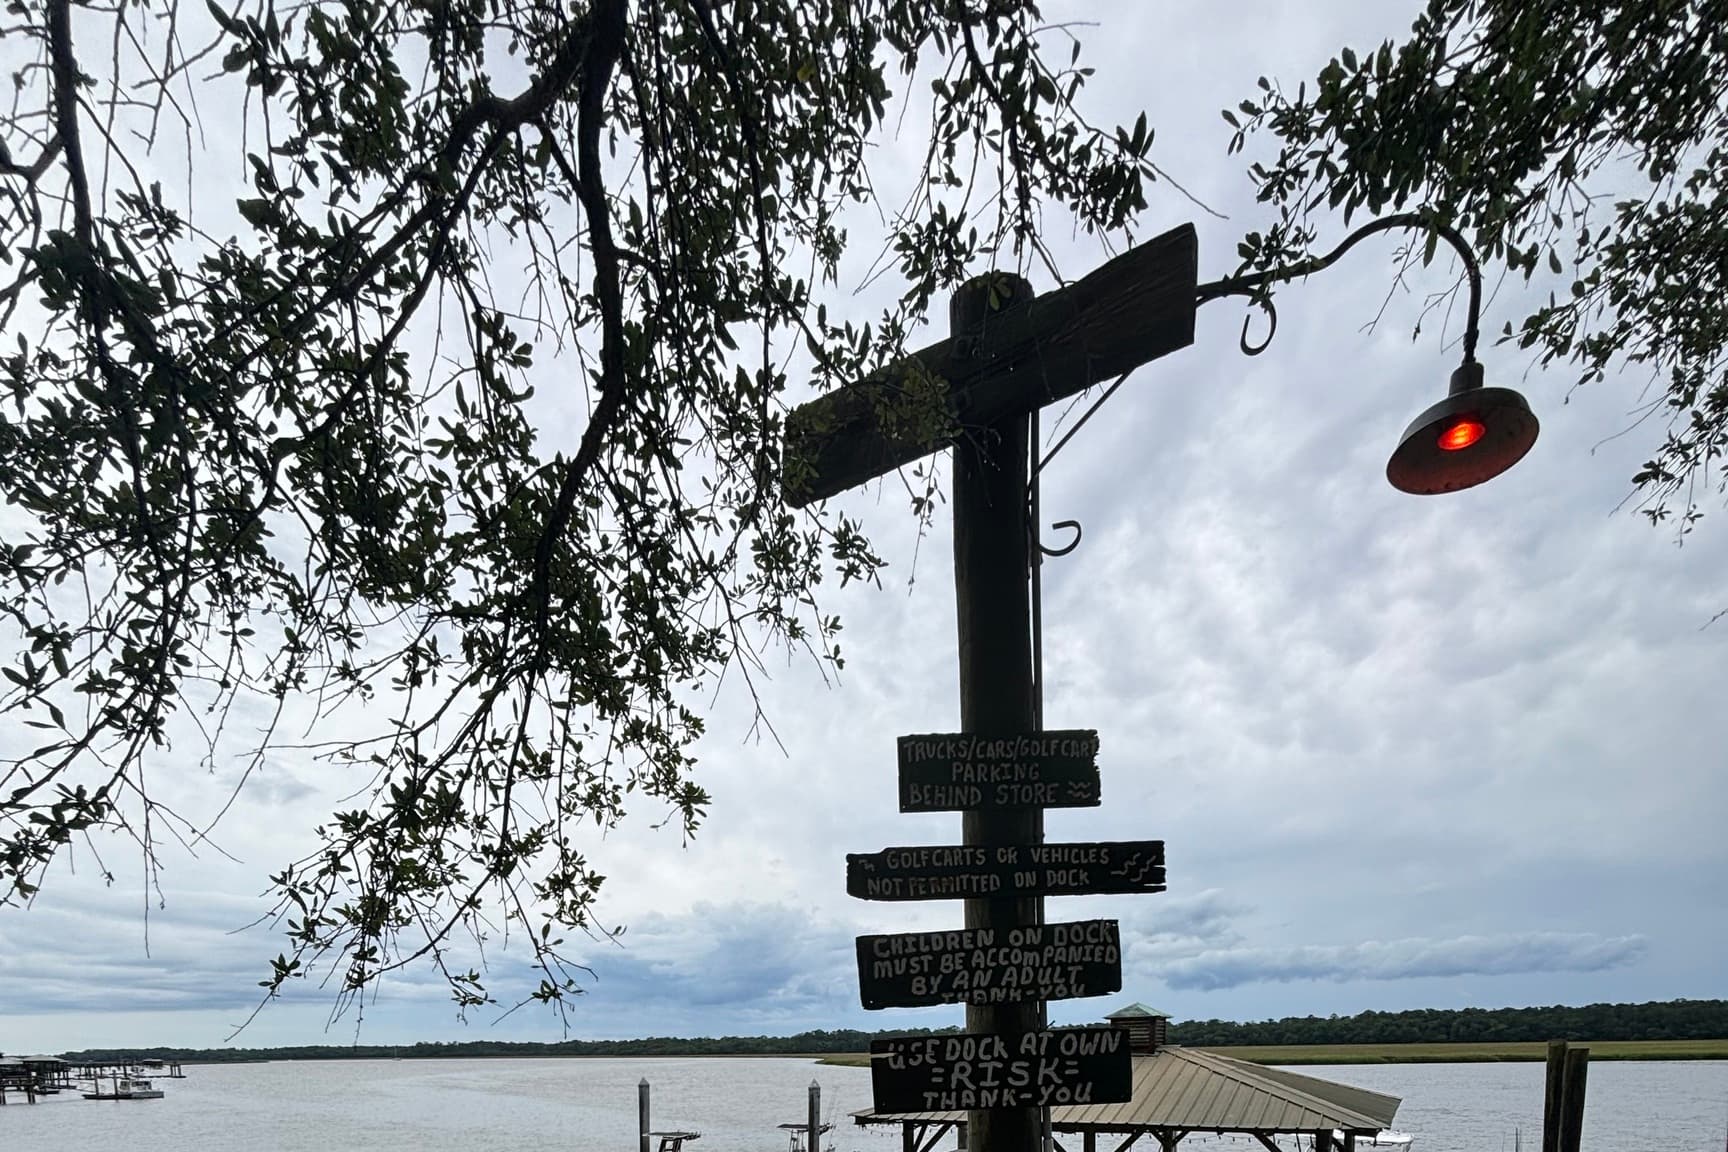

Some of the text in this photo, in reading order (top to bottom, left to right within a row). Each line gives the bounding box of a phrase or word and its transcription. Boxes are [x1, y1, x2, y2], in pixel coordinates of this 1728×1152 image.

[952, 761, 1040, 783] PARKING
[909, 783, 1059, 806] BEHIND STORE
[1031, 847, 1110, 865] VEHICLES
[867, 868, 1089, 896] NOT PERMITTED ON DOCK
[873, 921, 1114, 958] CHILDREN ON DOCK
[874, 954, 933, 979] MUST
[940, 952, 966, 974] BE
[911, 965, 1083, 995] BY AN ADULT
[887, 1030, 1122, 1070] USE DOCK AT OWN
